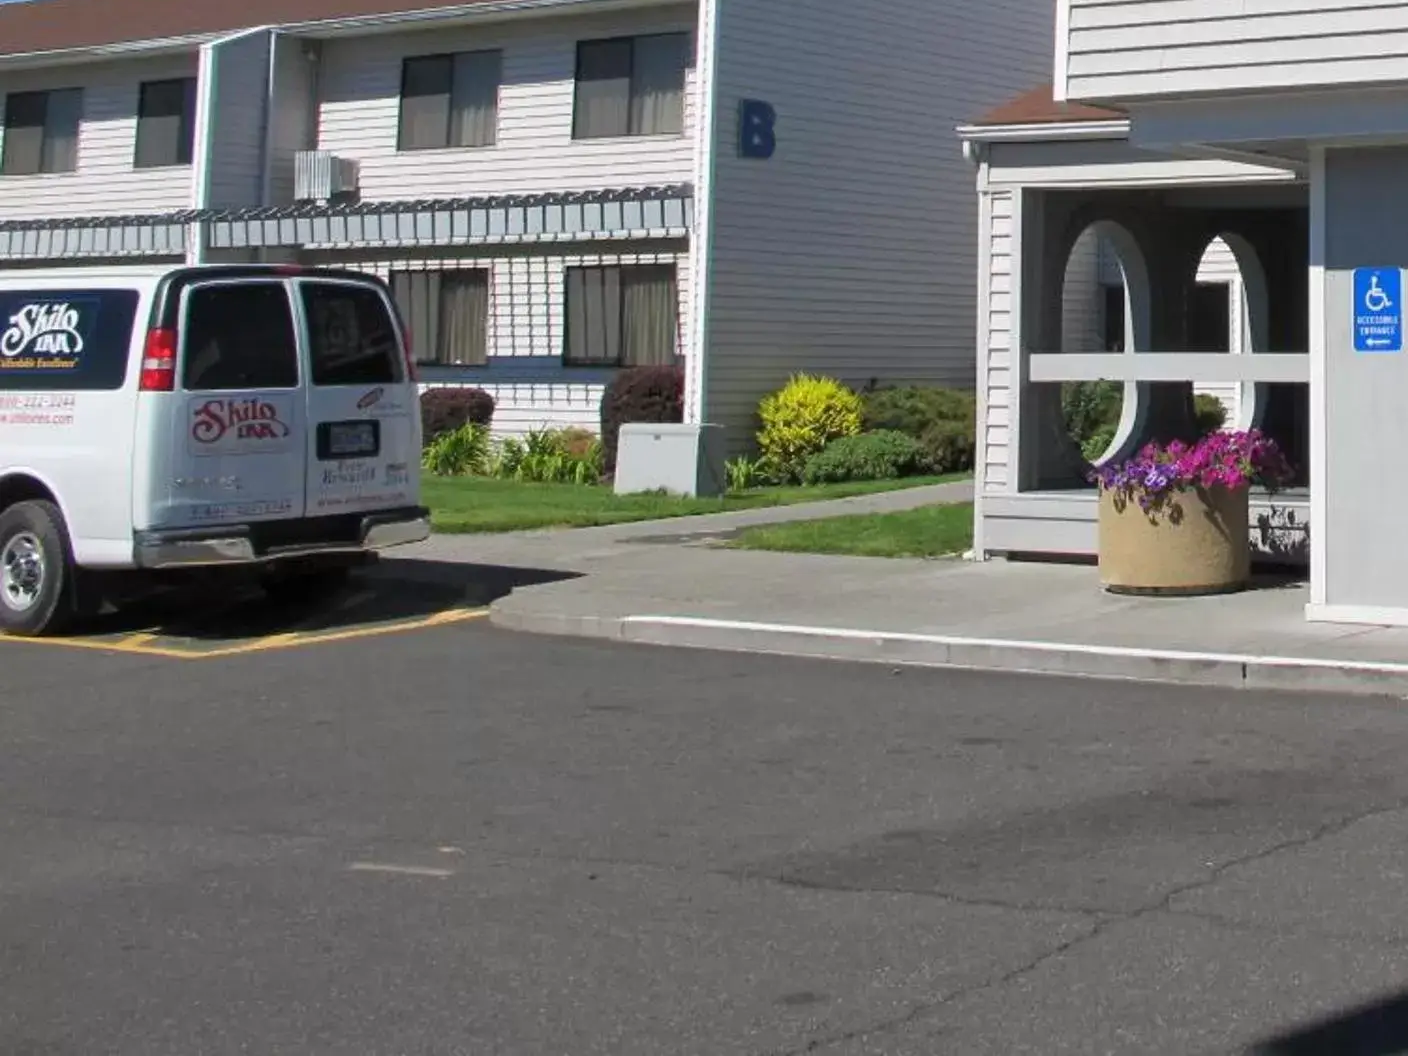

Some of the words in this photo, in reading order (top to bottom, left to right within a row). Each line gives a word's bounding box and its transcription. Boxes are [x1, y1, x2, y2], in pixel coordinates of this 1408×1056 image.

[737, 98, 777, 160] B
[1, 303, 84, 356] Shilo
[193, 399, 289, 443] Shilo
